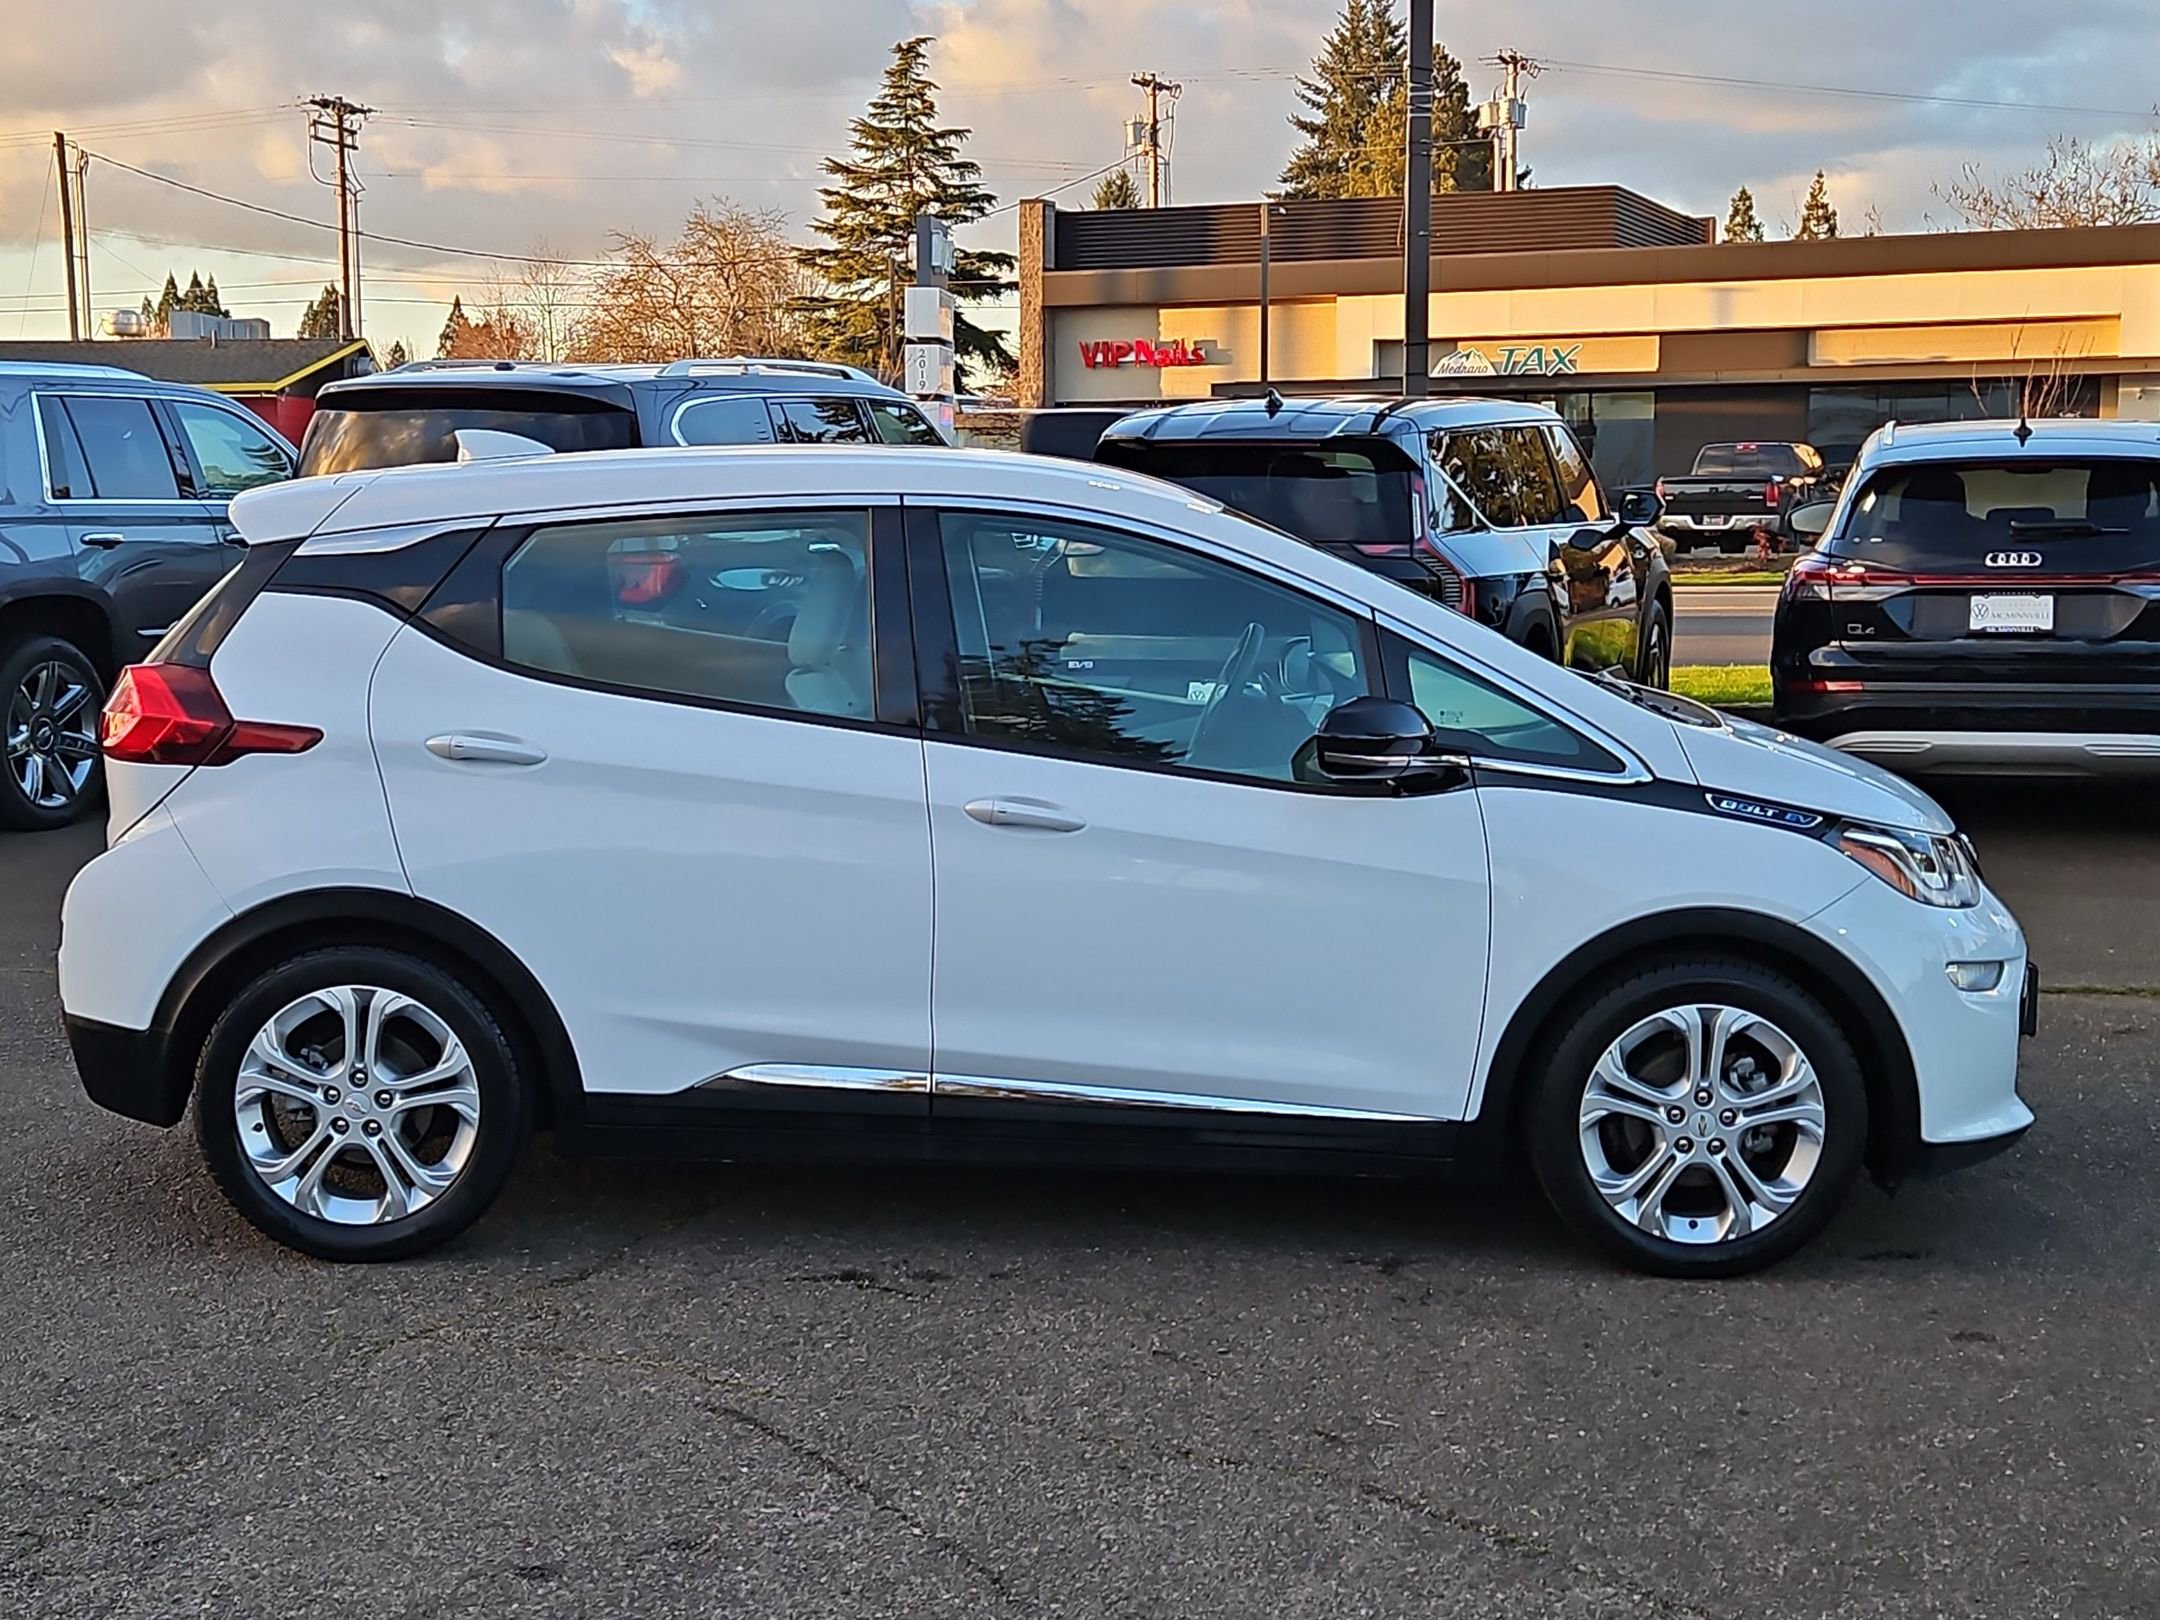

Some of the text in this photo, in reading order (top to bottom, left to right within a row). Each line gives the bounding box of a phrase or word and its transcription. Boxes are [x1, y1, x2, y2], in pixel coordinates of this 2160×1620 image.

[1079, 338, 1206, 368] VIP Nails
[1438, 361, 1488, 375] Medrano
[1497, 344, 1583, 376] TAX
[918, 348, 926, 390] 2019
[1719, 799, 1813, 824] BOLT EV
